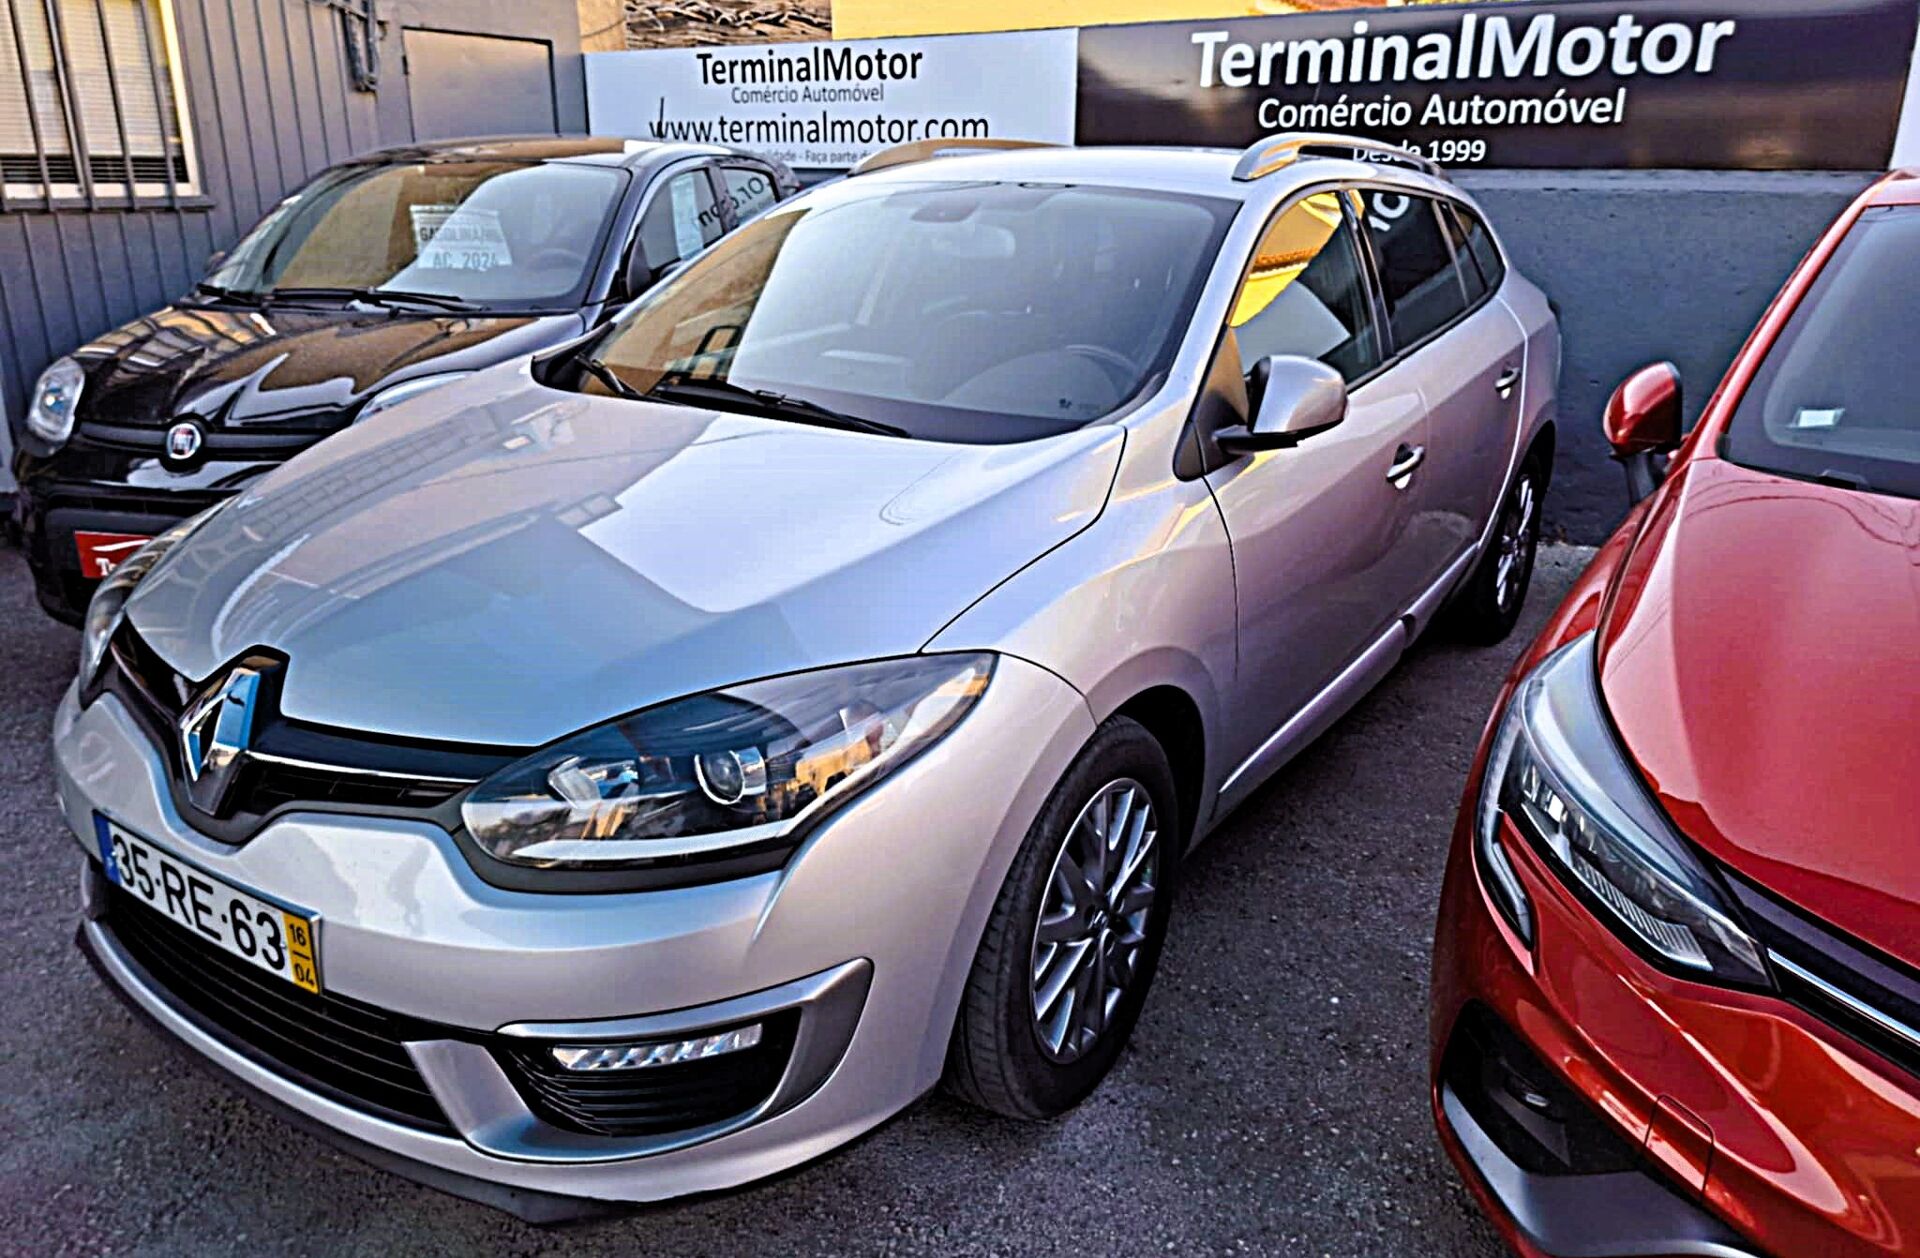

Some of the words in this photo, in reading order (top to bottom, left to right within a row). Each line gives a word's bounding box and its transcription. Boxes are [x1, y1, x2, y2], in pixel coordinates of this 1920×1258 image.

[1191, 13, 1735, 88] TerminalMotor
[696, 46, 923, 85] TerminalMotor
[731, 86, 798, 103] Comércio
[802, 82, 884, 102] Automóvel
[1258, 94, 1411, 128] Comércio
[1420, 88, 1626, 126] Automóvel
[649, 110, 989, 144] www.terminalmotor.com
[805, 149, 828, 165] Faça
[830, 151, 858, 164] parte
[1427, 139, 1486, 162] 1999
[289, 924, 307, 947] 16
[295, 963, 315, 986] 04
